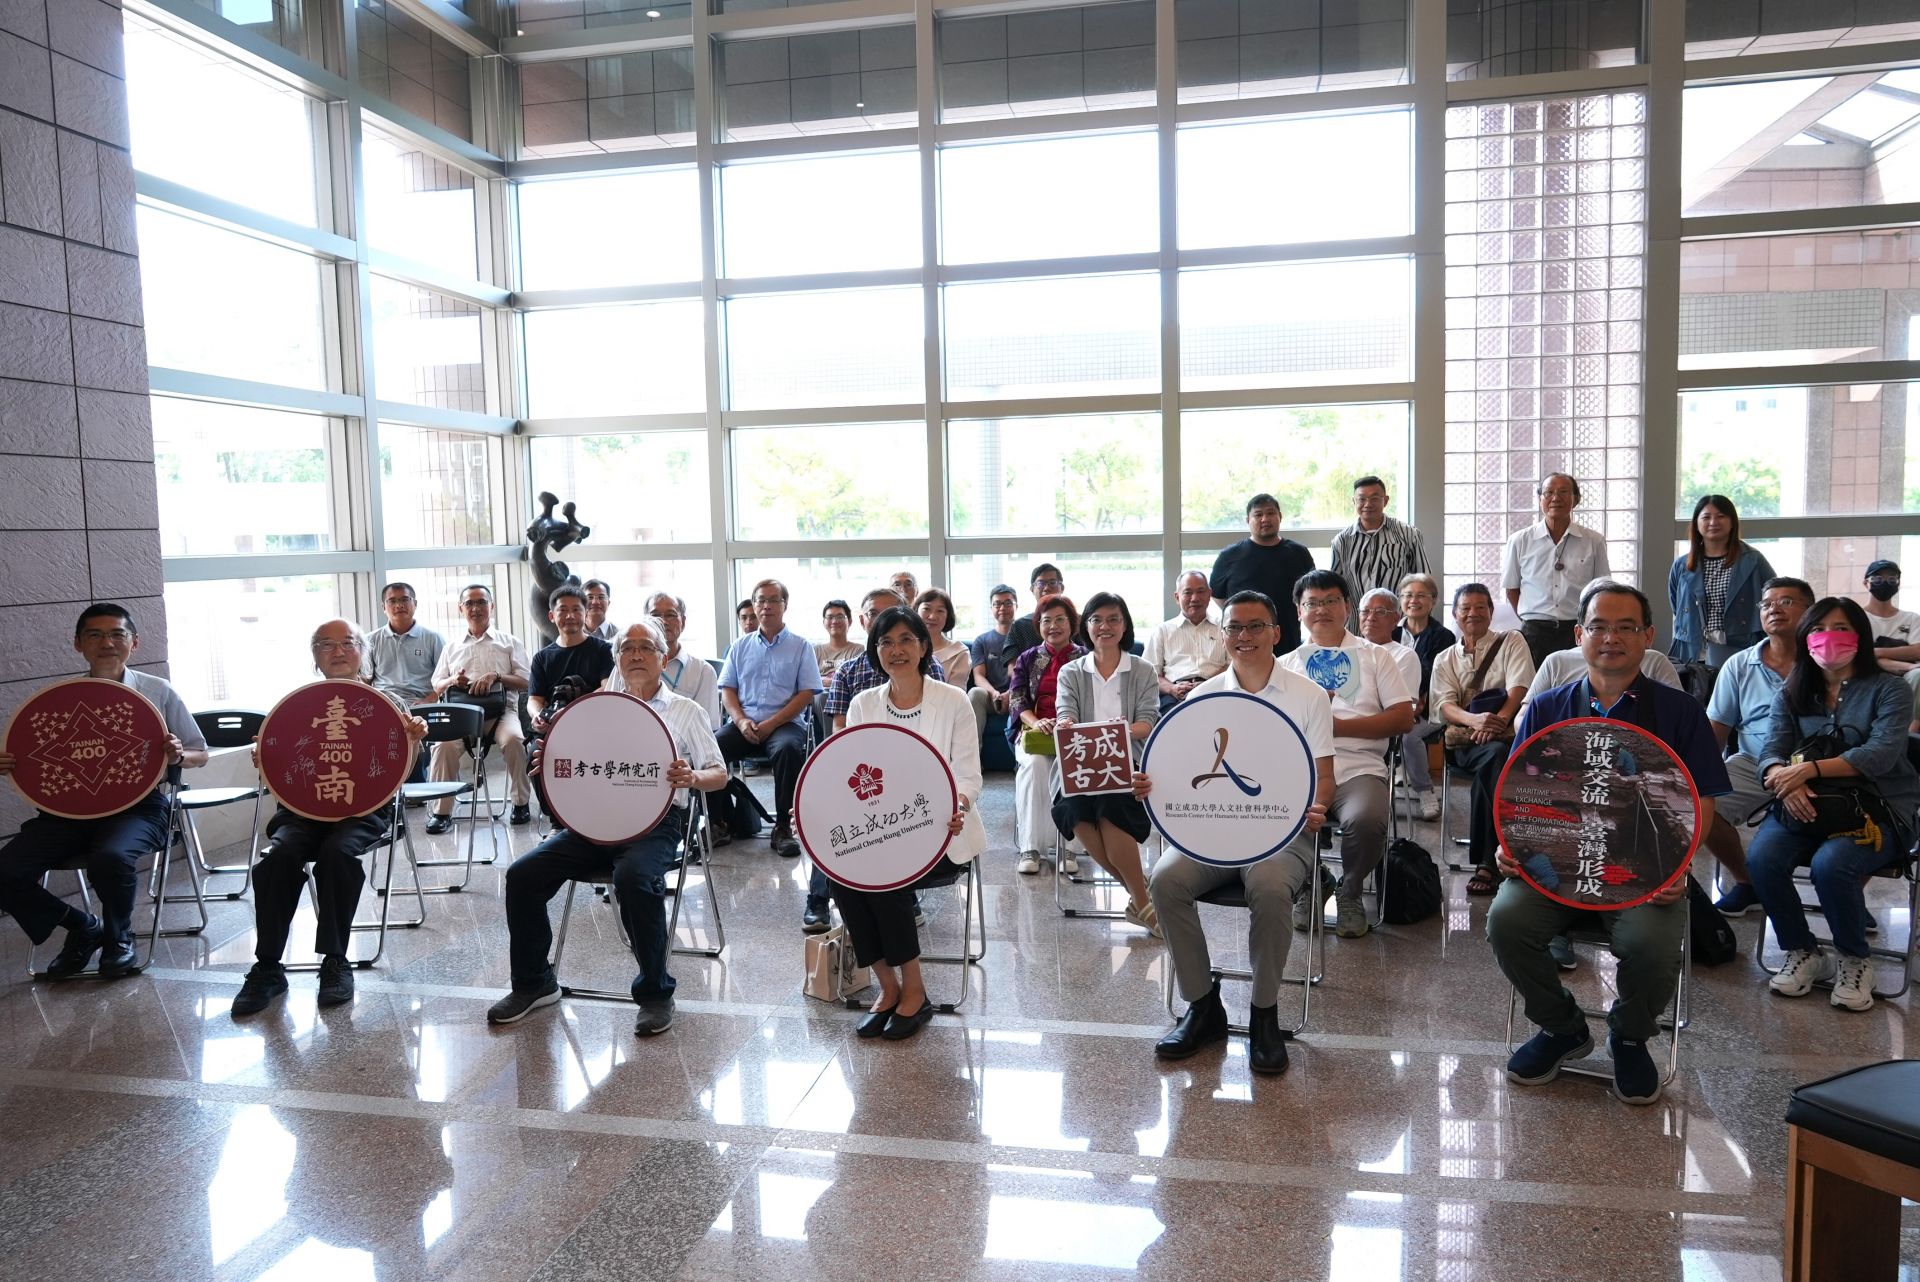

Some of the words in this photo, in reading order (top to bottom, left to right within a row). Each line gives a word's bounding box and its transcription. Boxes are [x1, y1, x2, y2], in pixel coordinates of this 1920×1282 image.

[311, 695, 362, 740] 臺
[69, 738, 105, 749] TAINAN
[70, 745, 106, 760] 400
[319, 742, 352, 750] TAINAN
[319, 750, 352, 763] 400
[1063, 731, 1096, 789] 考古
[1092, 727, 1130, 788] 成大
[574, 760, 661, 779] 考古學研究所
[1581, 731, 1613, 806] 海域交流
[314, 765, 355, 805] 南
[1516, 787, 1550, 797] MARITIME
[1165, 802, 1290, 814] 國立成功大學人文社會科學中心
[1515, 796, 1553, 806] EXCHANGE
[829, 792, 932, 848] 國立成功大學
[1528, 816, 1570, 827] FORMATION
[835, 843, 863, 858] National
[862, 836, 884, 848] Cheng
[883, 830, 902, 842] Kung
[900, 818, 934, 835] University
[1573, 820, 1608, 897] 臺灣形成
